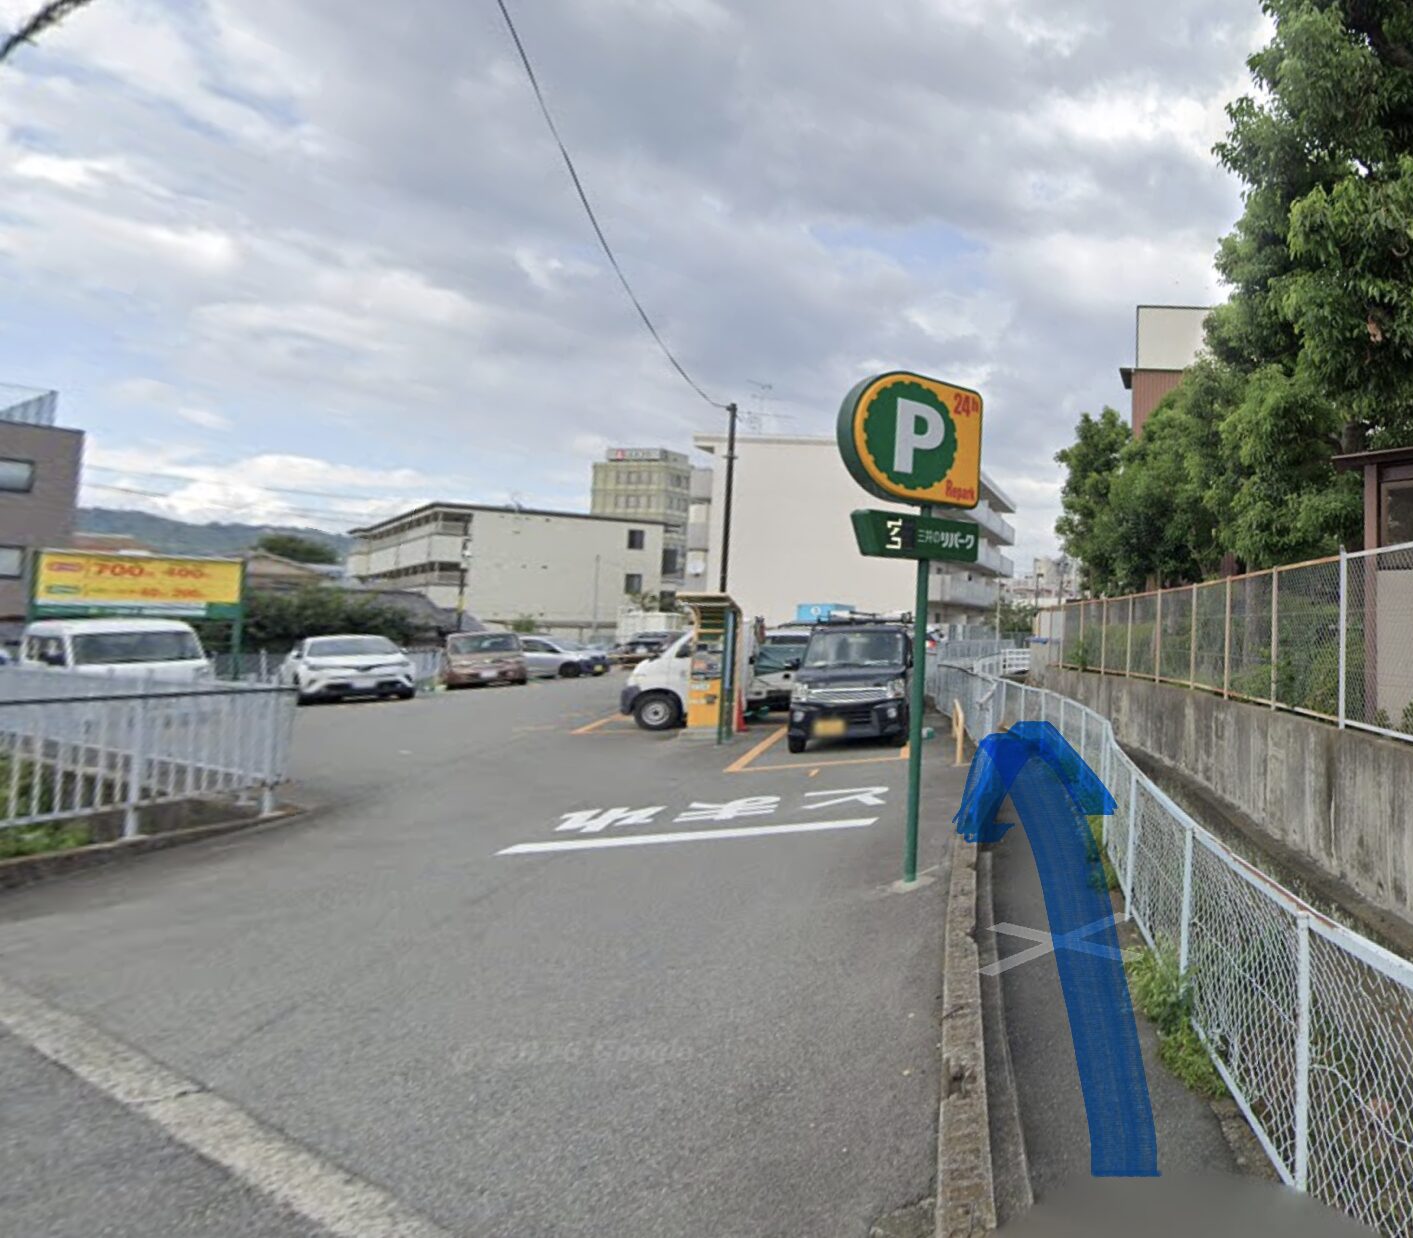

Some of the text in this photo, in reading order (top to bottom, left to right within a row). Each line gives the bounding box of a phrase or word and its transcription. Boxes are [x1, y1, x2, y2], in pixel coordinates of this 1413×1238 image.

[953, 392, 979, 417] 24h
[893, 397, 945, 474] P
[945, 479, 975, 500] Repark
